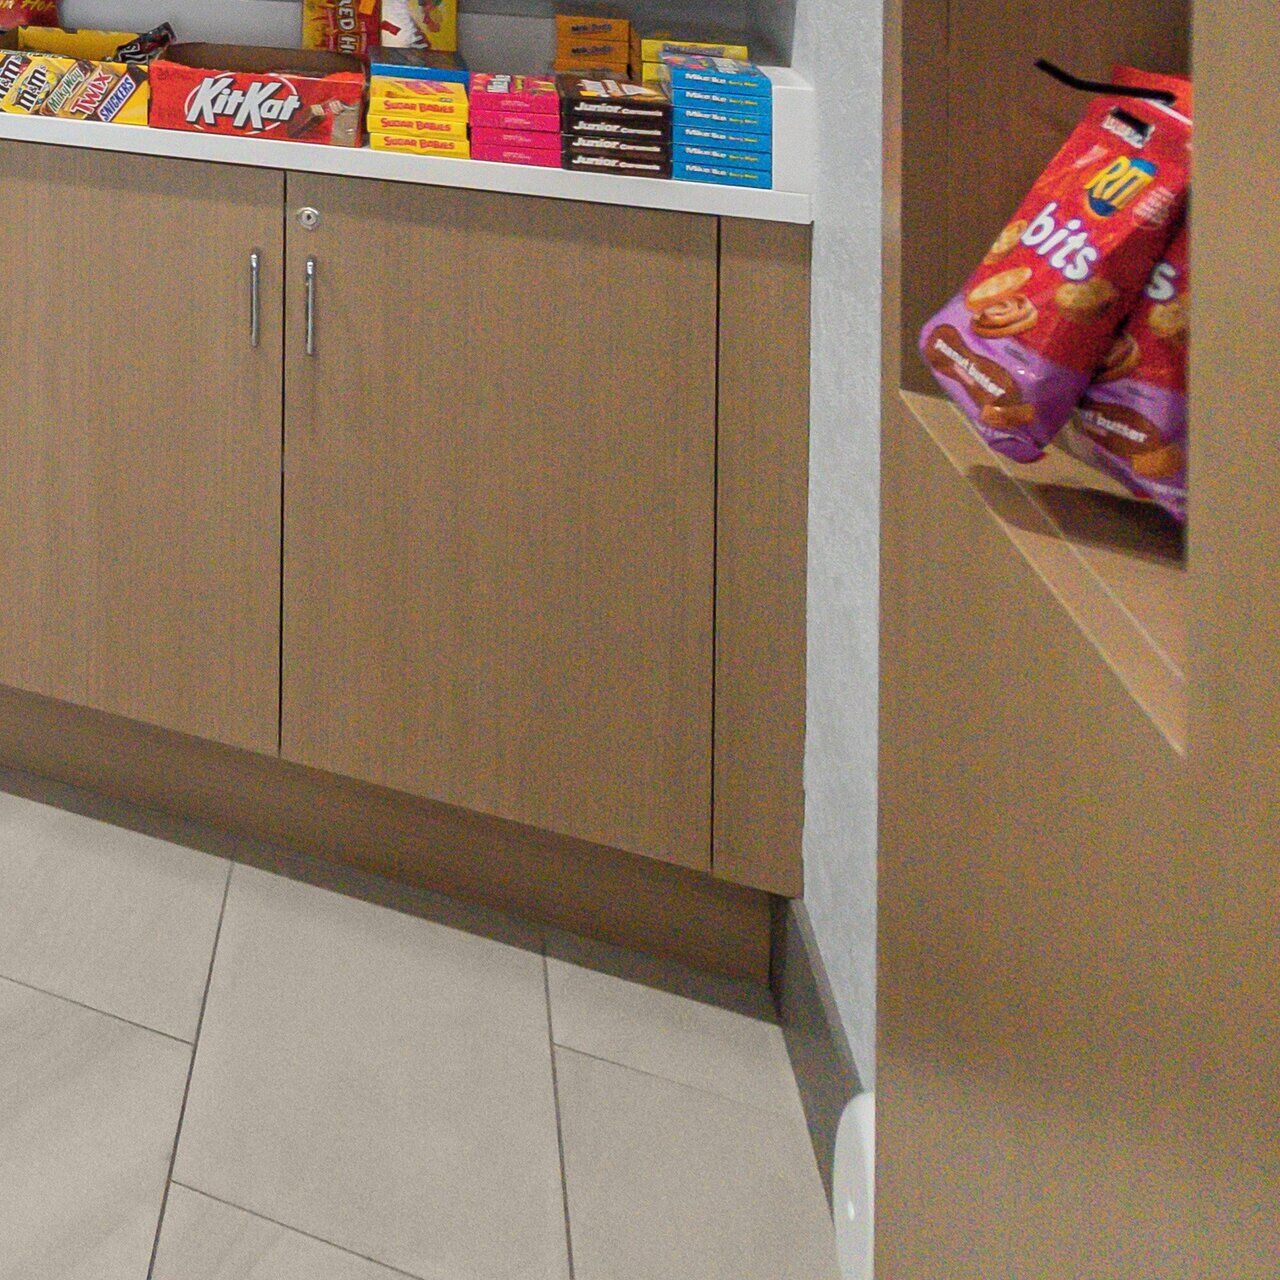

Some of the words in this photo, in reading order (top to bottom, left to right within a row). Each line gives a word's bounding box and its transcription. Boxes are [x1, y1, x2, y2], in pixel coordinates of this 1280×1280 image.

[71, 71, 112, 116] TWIX
[100, 76, 135, 121] SNICKERS
[384, 100, 417, 111] SUGAR
[419, 103, 454, 113] BABIES
[574, 102, 621, 113] Junior
[381, 118, 413, 128] SUGAR
[416, 121, 451, 131] BABIES
[573, 120, 620, 131] Junior
[384, 136, 417, 147] SUGAR
[420, 139, 455, 149] BABIES
[572, 137, 619, 148] Junior
[572, 155, 619, 166] Junior
[1022, 203, 1097, 279] bits
